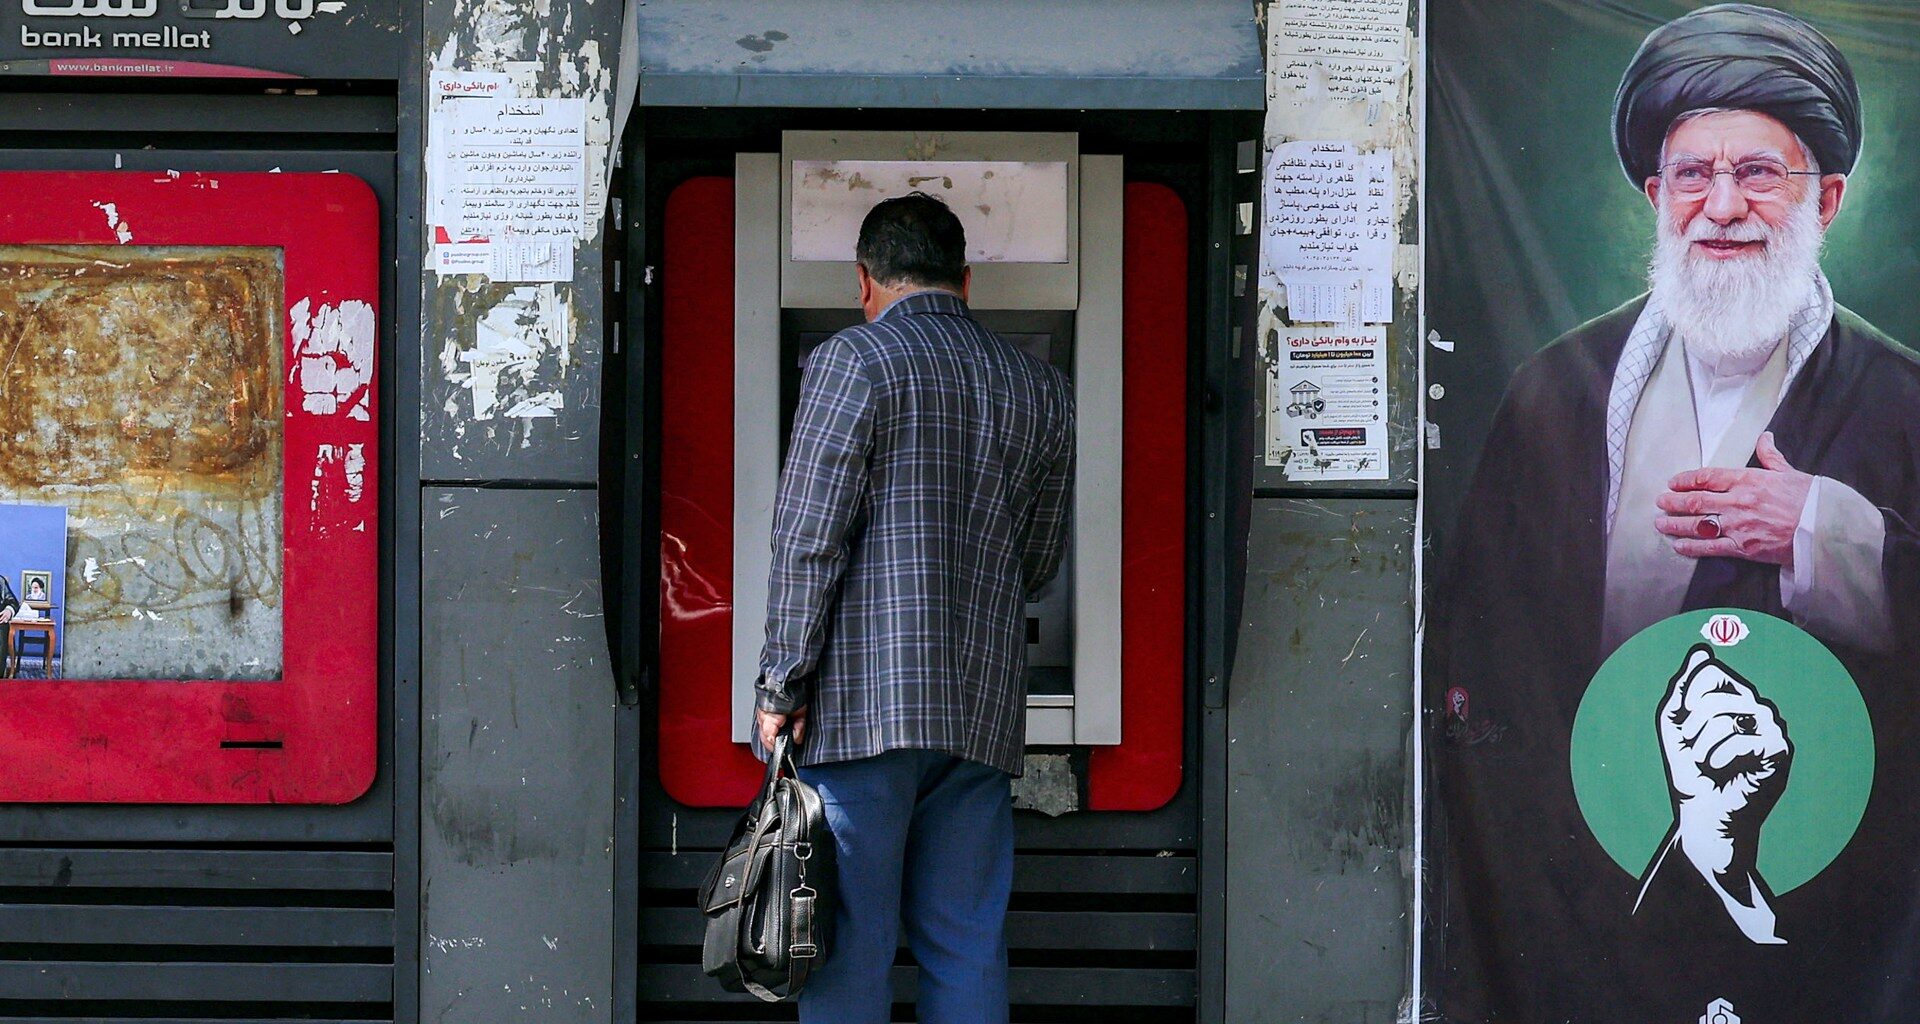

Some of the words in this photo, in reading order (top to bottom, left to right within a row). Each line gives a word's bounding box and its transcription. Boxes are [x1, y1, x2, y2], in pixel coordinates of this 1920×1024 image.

[21, 24, 102, 47] bank
[113, 25, 210, 48] mellat
[57, 64, 174, 73] www.bankmellat.ir
[438, 80, 462, 91] داری؟
[463, 81, 486, 92] بانکی
[497, 104, 544, 120] استخدام
[534, 126, 555, 135] نگهبان
[1311, 144, 1345, 155] استخدام
[1275, 158, 1307, 171] نظافتچی
[1309, 160, 1332, 170] وخانم
[1274, 174, 1294, 183] جهت
[547, 201, 563, 209] جهت
[1309, 214, 1328, 224] بطور
[1299, 242, 1334, 252] نیازمندیم
[1337, 243, 1359, 252] خواب
[1286, 336, 1310, 347] داری؟
[1311, 335, 1333, 347] بانکی
[1334, 336, 1350, 346] وام
[1351, 337, 1360, 346] به
[1360, 335, 1377, 346] نیاز
